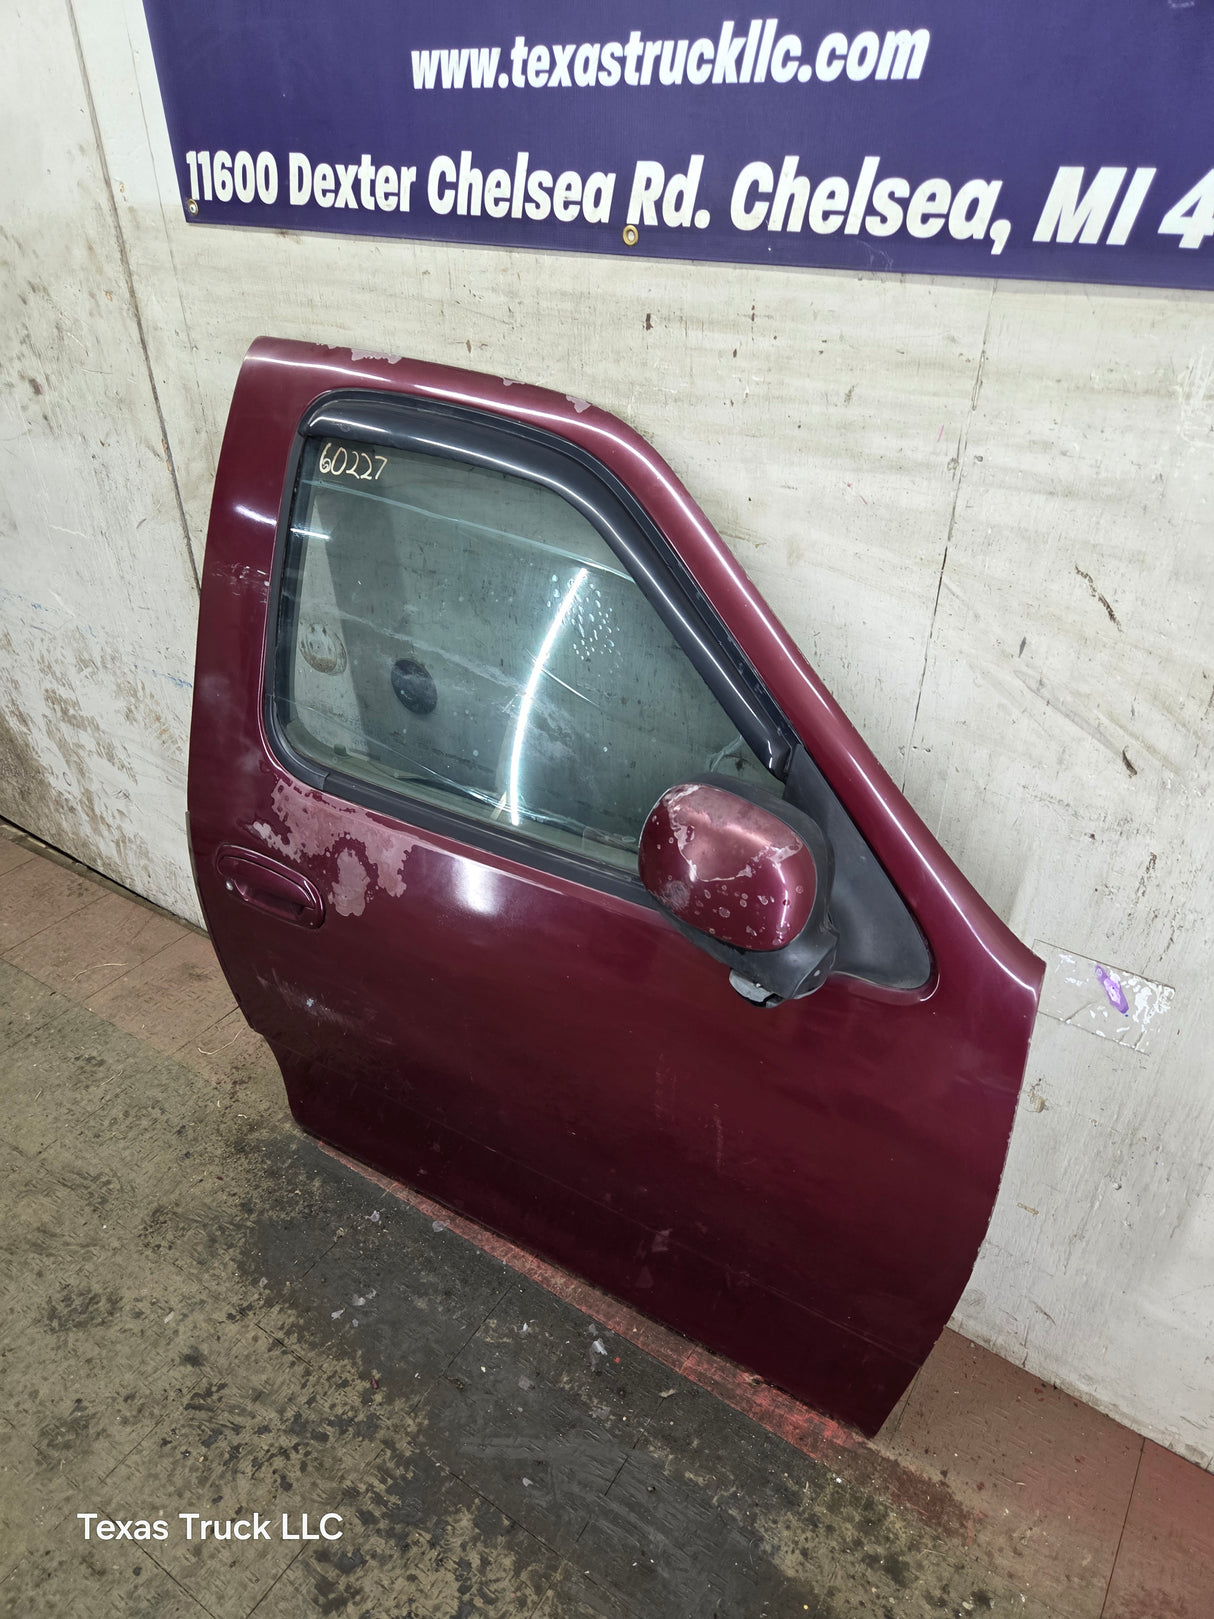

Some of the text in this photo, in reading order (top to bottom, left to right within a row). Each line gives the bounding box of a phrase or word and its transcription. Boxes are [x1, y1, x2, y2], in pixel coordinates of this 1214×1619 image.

[411, 18, 931, 90] www.texastruckllc.com
[185, 150, 1214, 255] 11600 Dexter Chelsea Rd. Chelsea, MI 4
[319, 442, 388, 480] 60227
